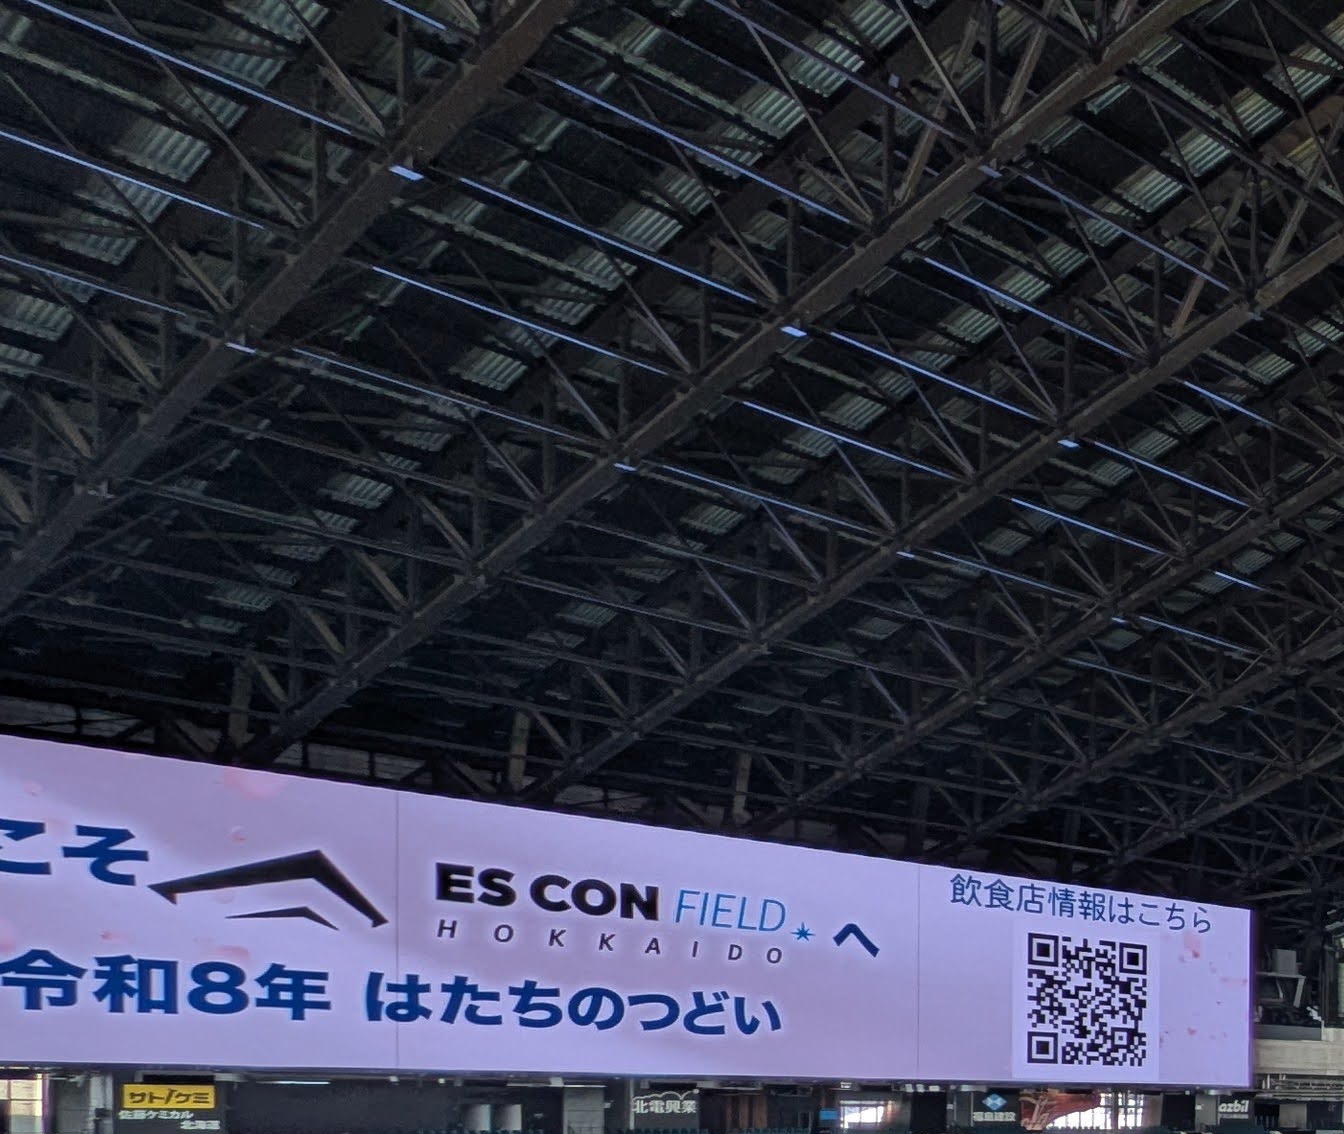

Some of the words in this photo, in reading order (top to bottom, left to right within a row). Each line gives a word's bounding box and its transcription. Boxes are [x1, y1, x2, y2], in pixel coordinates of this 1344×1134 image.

[674, 889, 786, 933] FIELD
[950, 873, 1212, 935] 飲食店情報はこちら
[436, 918, 783, 965] HOKKAIDO
[1, 949, 332, 1022] 令和8年
[366, 972, 782, 1036] はたちのつどい
[1218, 1099, 1249, 1113] azbil
